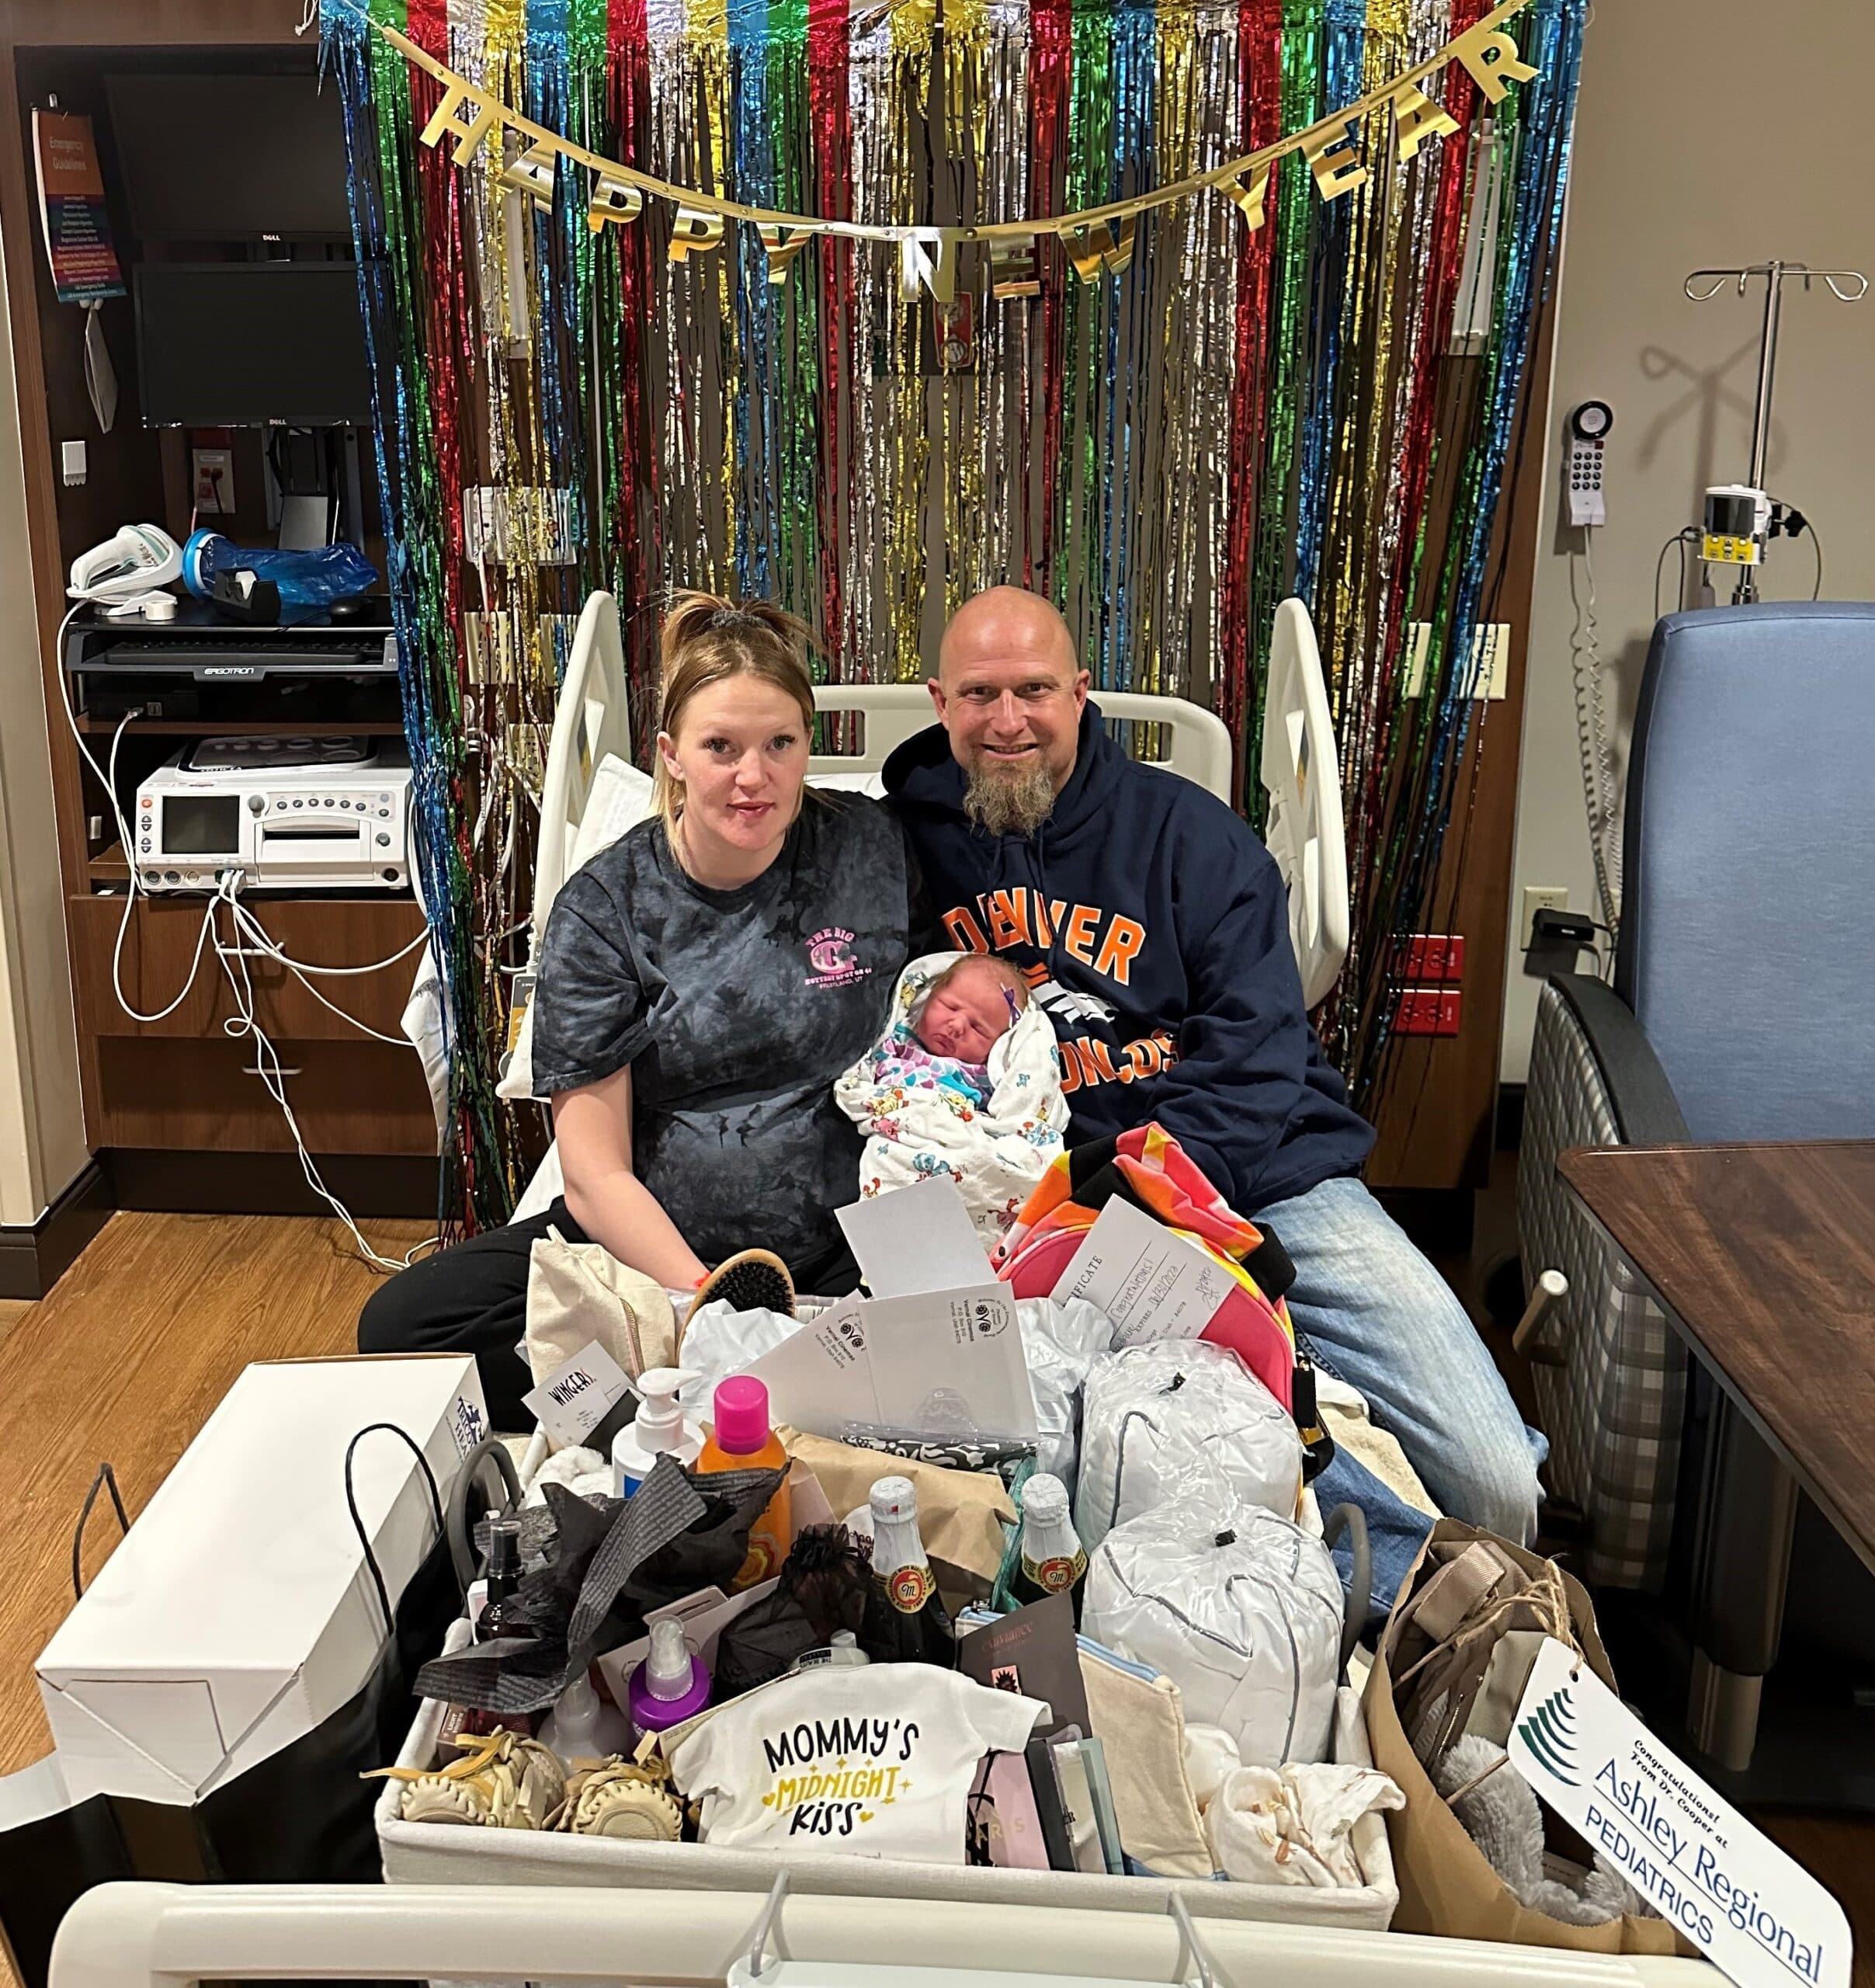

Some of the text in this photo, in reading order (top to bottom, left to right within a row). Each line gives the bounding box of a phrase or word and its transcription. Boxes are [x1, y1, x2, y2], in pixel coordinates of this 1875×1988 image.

[419, 30, 1540, 302] HAPPY NEW YEAR
[805, 927, 855, 947] THE BIG
[941, 887, 1146, 985] DENVER
[1058, 1027, 1179, 1094] ONOS
[548, 1368, 595, 1406] WINGERS
[763, 1717, 919, 1773] MOMMY'S
[1634, 1740, 1720, 1823] Congratulations!
[775, 1767, 901, 1812] MIDNIGHT
[1630, 1751, 1729, 1849] From Dr. Cooper at
[1585, 1804, 1714, 1945] PEDIATRICS
[1595, 1758, 1823, 1983] Ashley Regional
